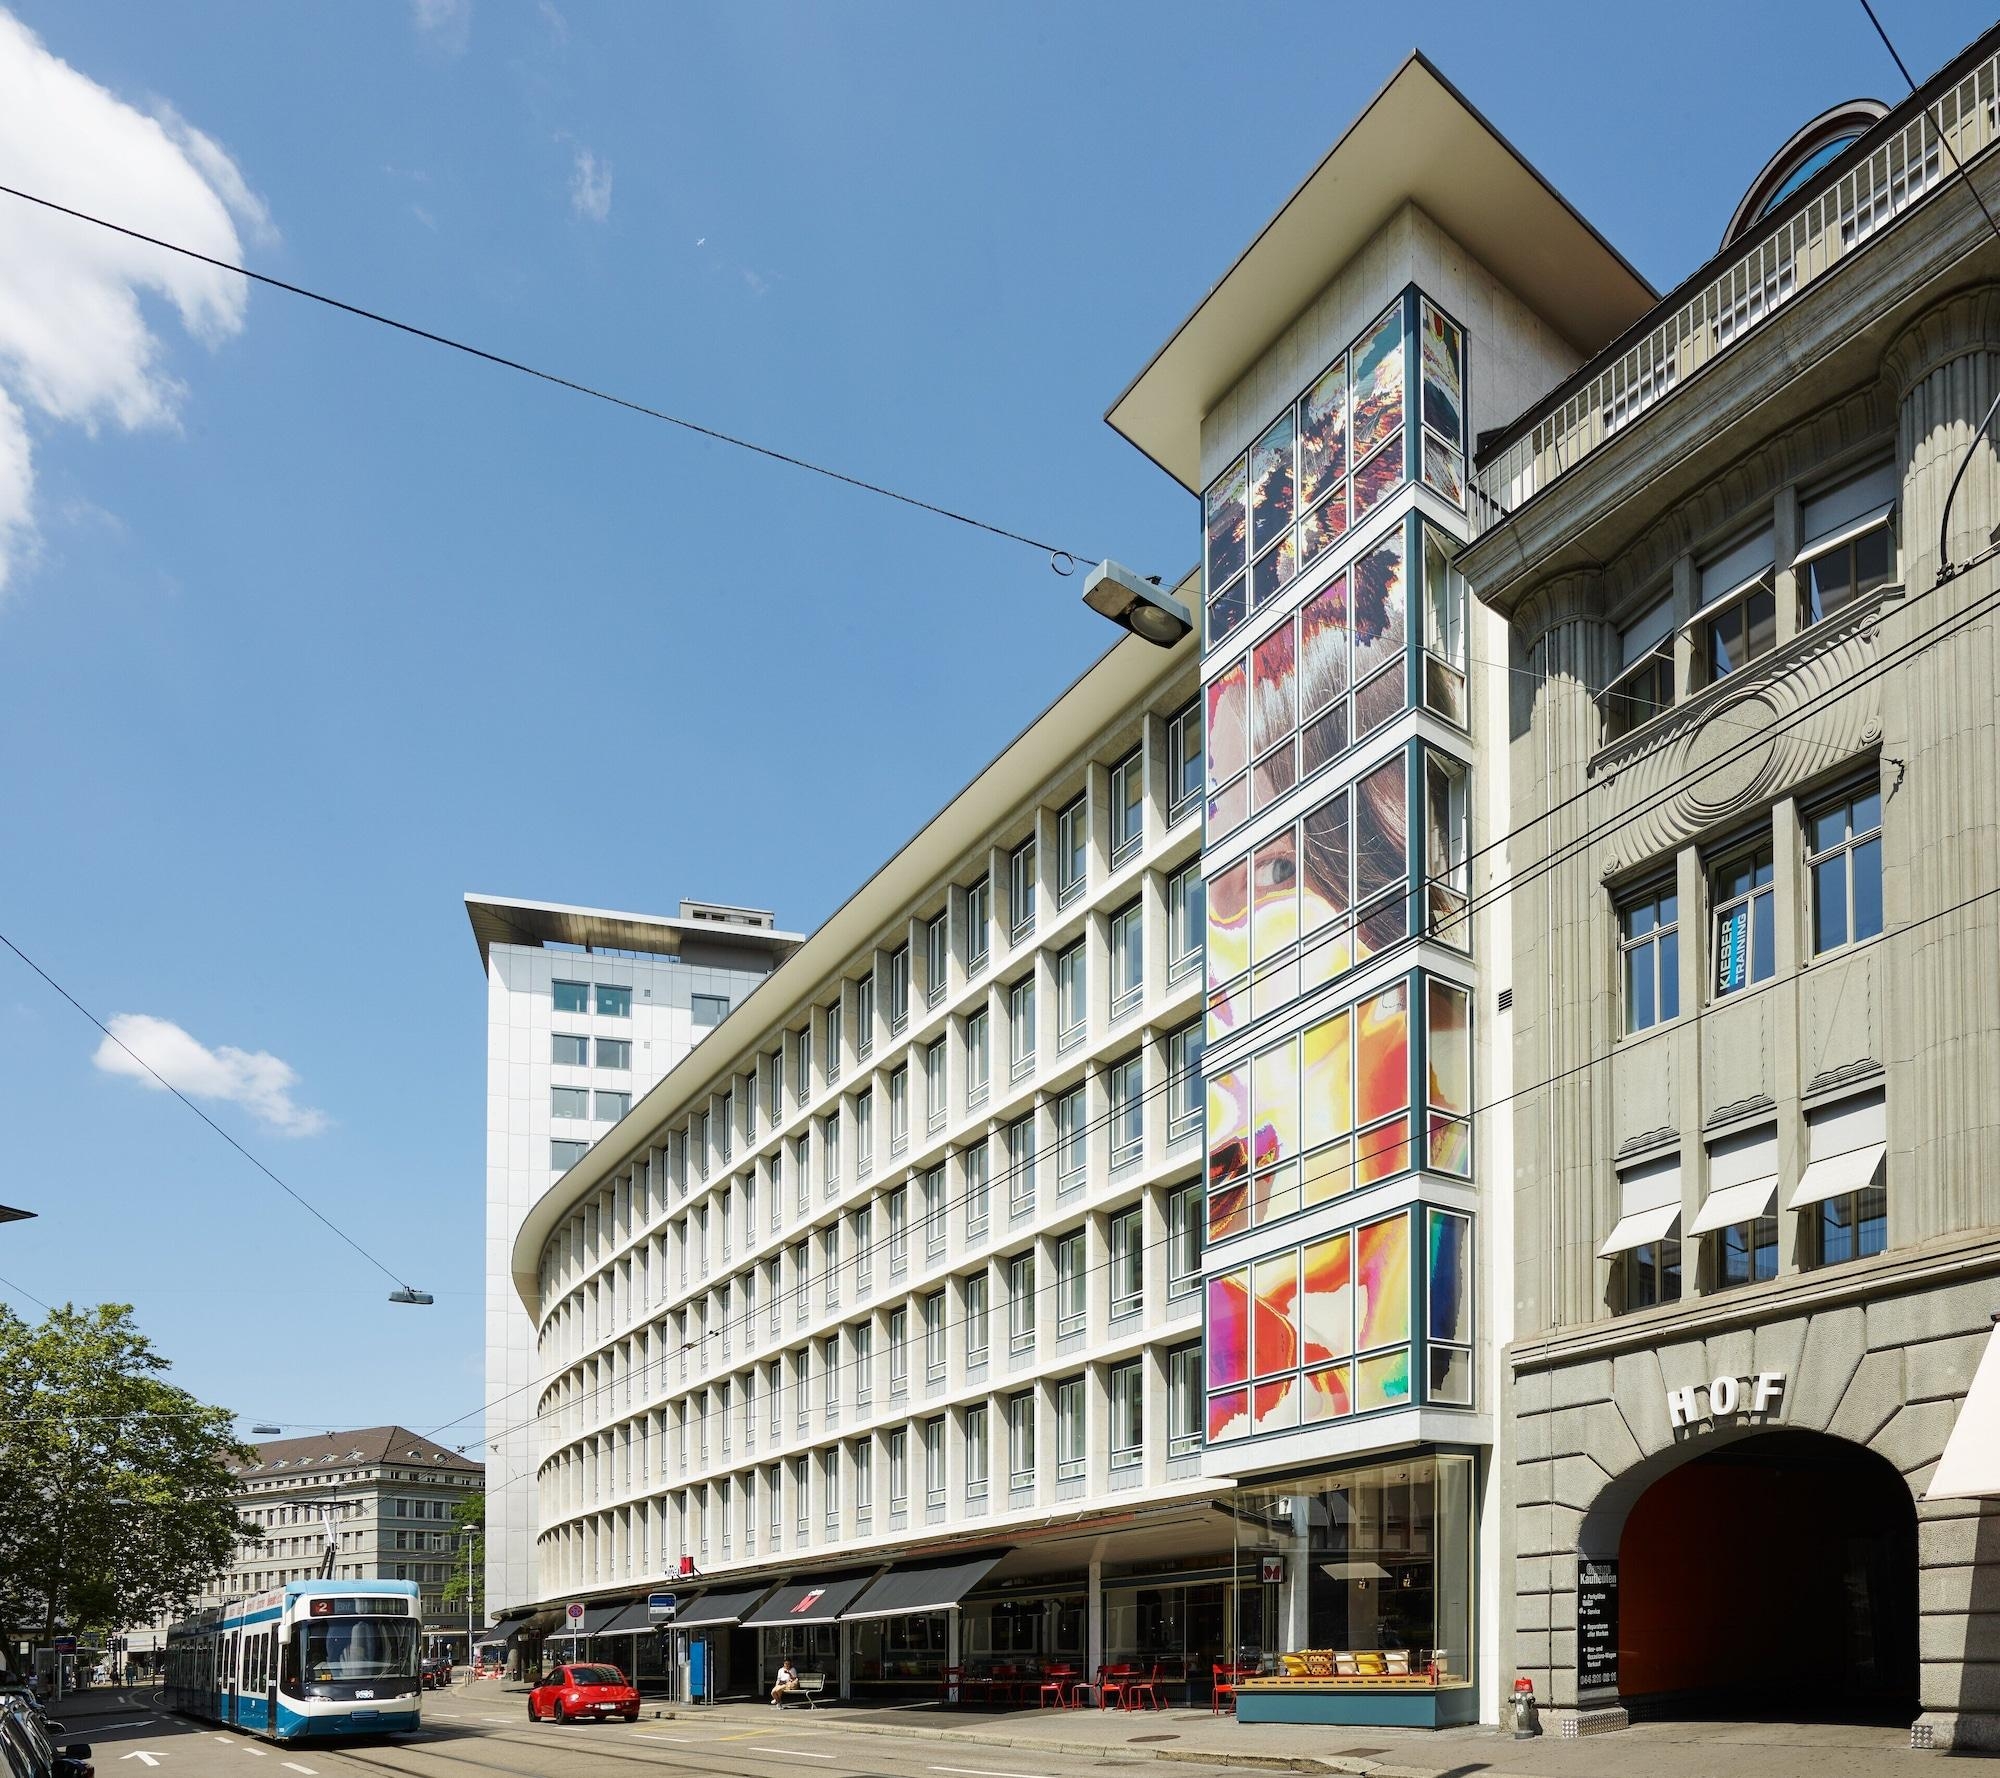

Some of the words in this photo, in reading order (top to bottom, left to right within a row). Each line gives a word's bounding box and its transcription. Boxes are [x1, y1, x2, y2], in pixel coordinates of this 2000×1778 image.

[1720, 919, 1733, 990] KIESER
[1735, 913, 1747, 984] TRAINING
[1667, 1372, 1784, 1427] HOF
[319, 1602, 328, 1612] 2
